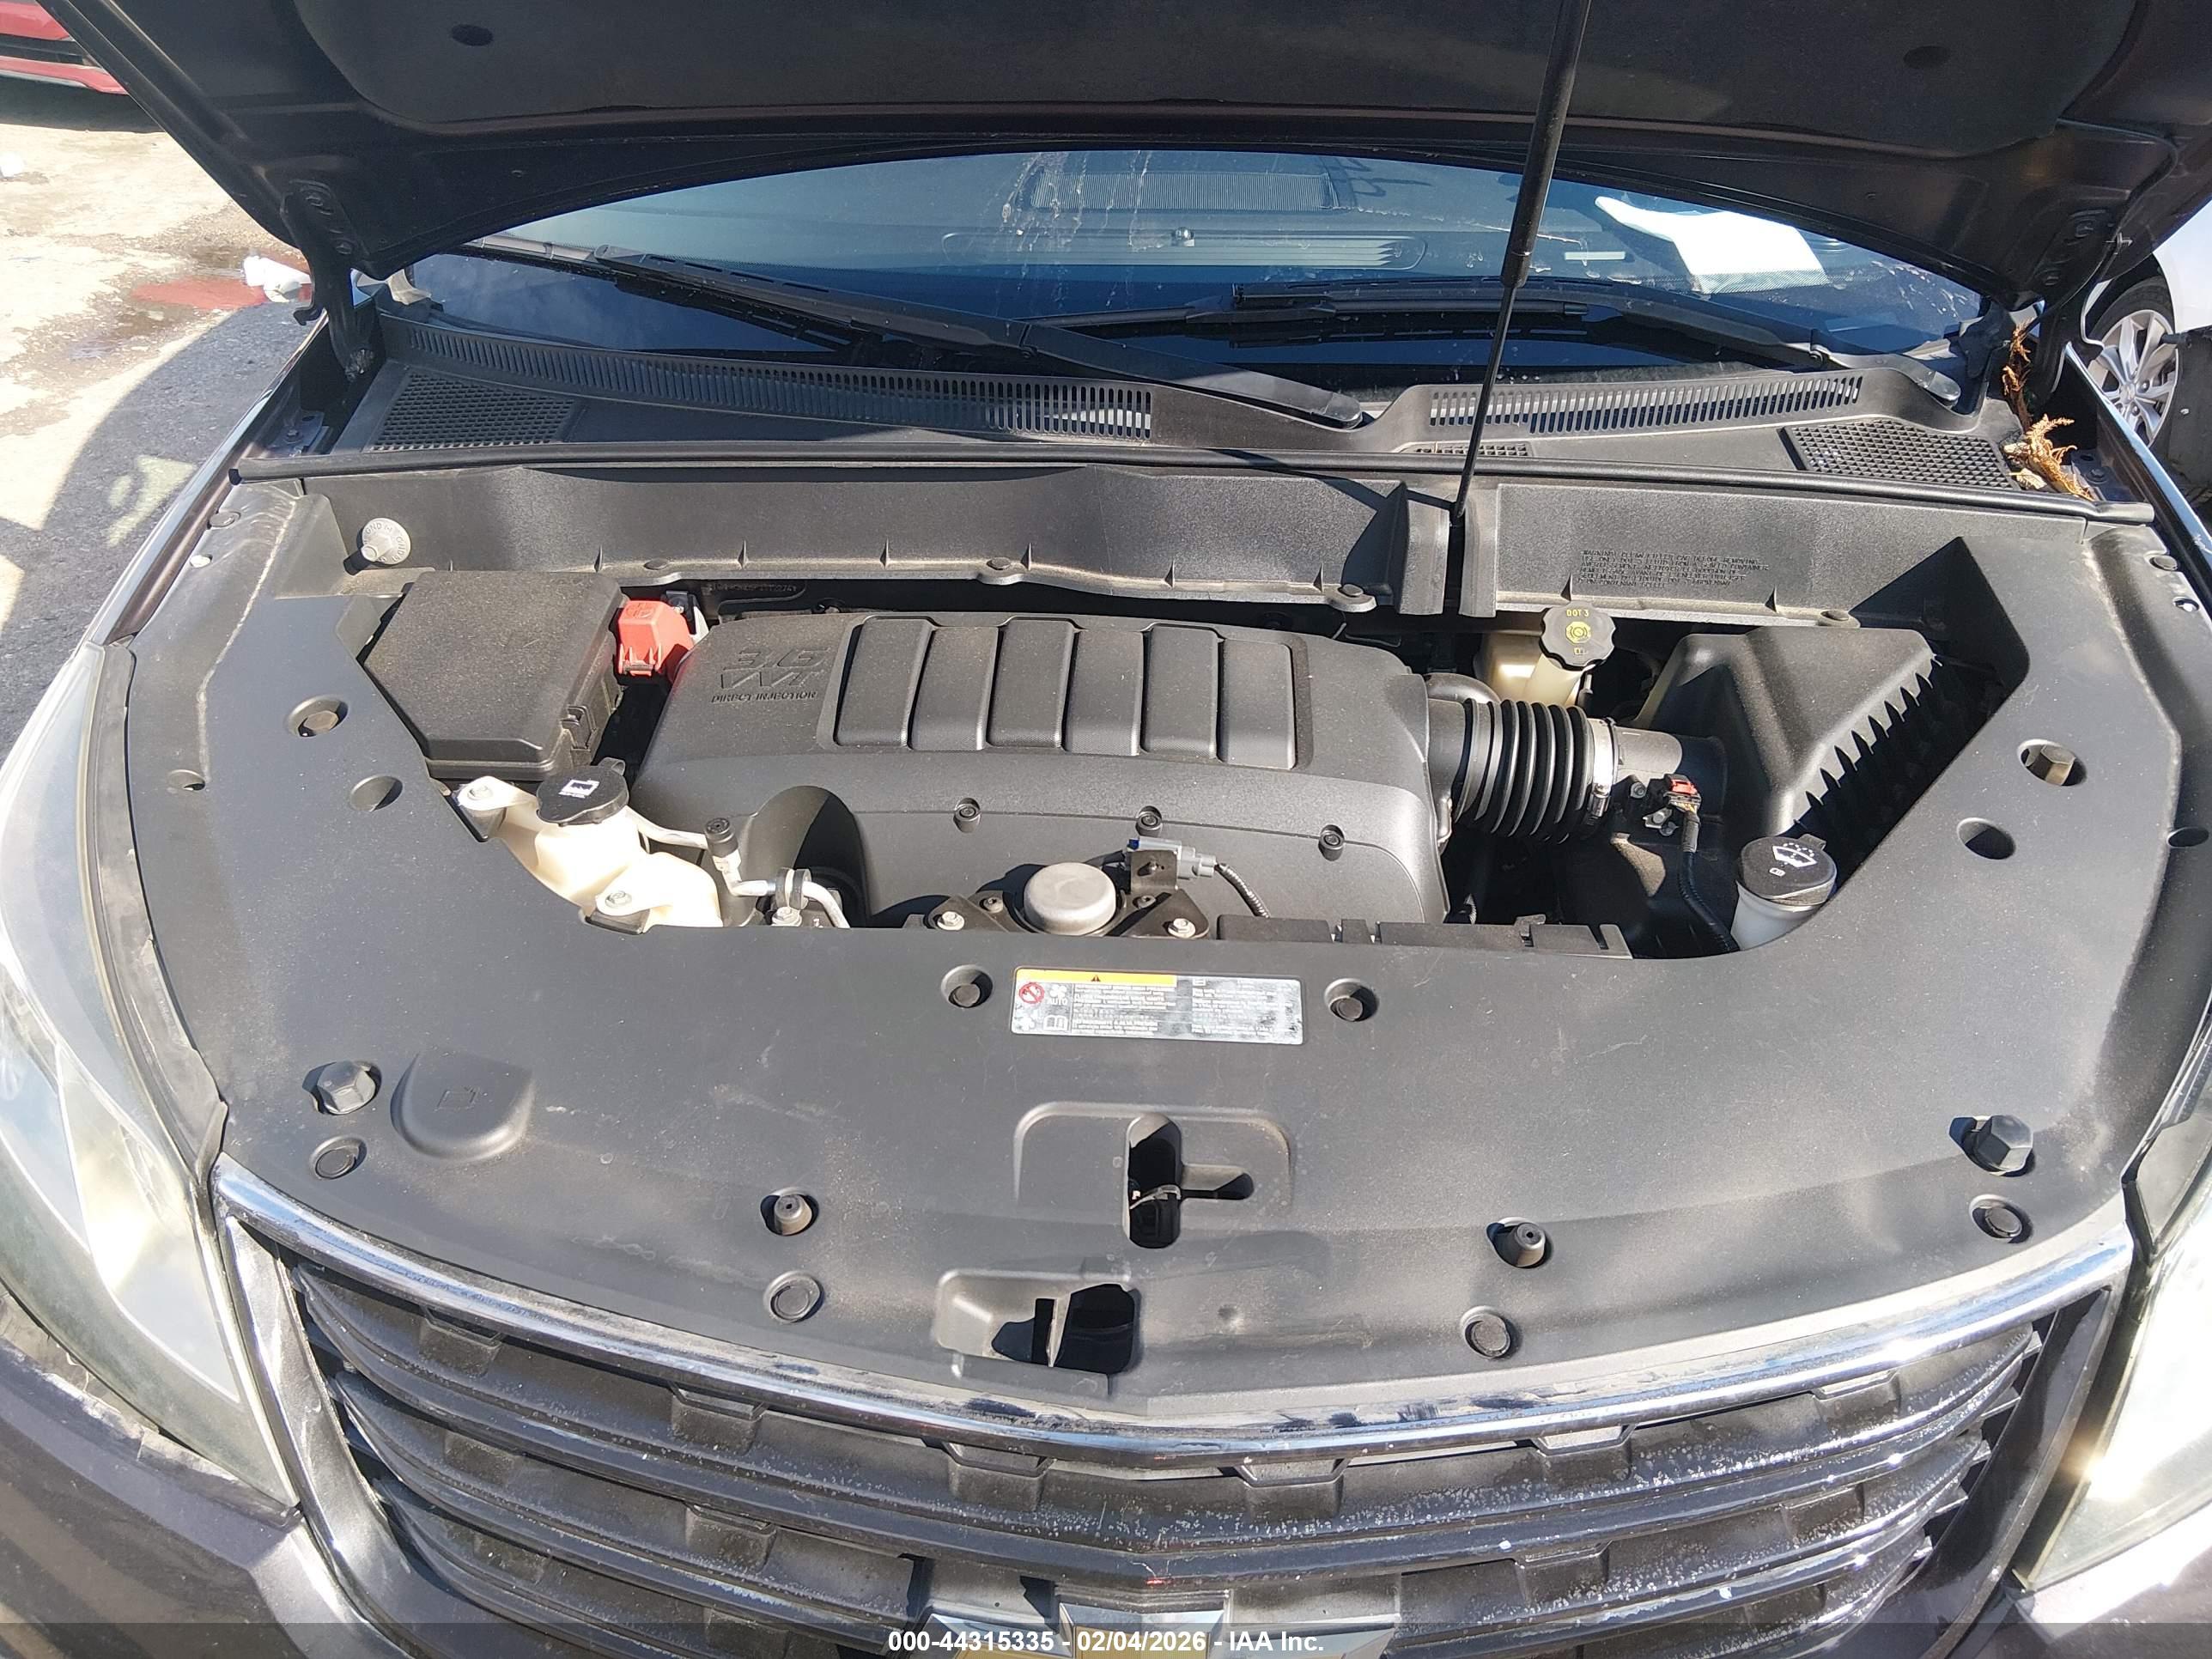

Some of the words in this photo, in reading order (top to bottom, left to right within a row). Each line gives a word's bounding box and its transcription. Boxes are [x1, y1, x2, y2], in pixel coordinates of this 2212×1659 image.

[365, 521, 382, 534] GND
[1566, 609, 1581, 617] DOT
[1583, 609, 1589, 617] 3
[711, 692, 752, 704] DIRECT
[756, 691, 817, 702] INJECTION
[1047, 997, 1068, 1006] AUTO
